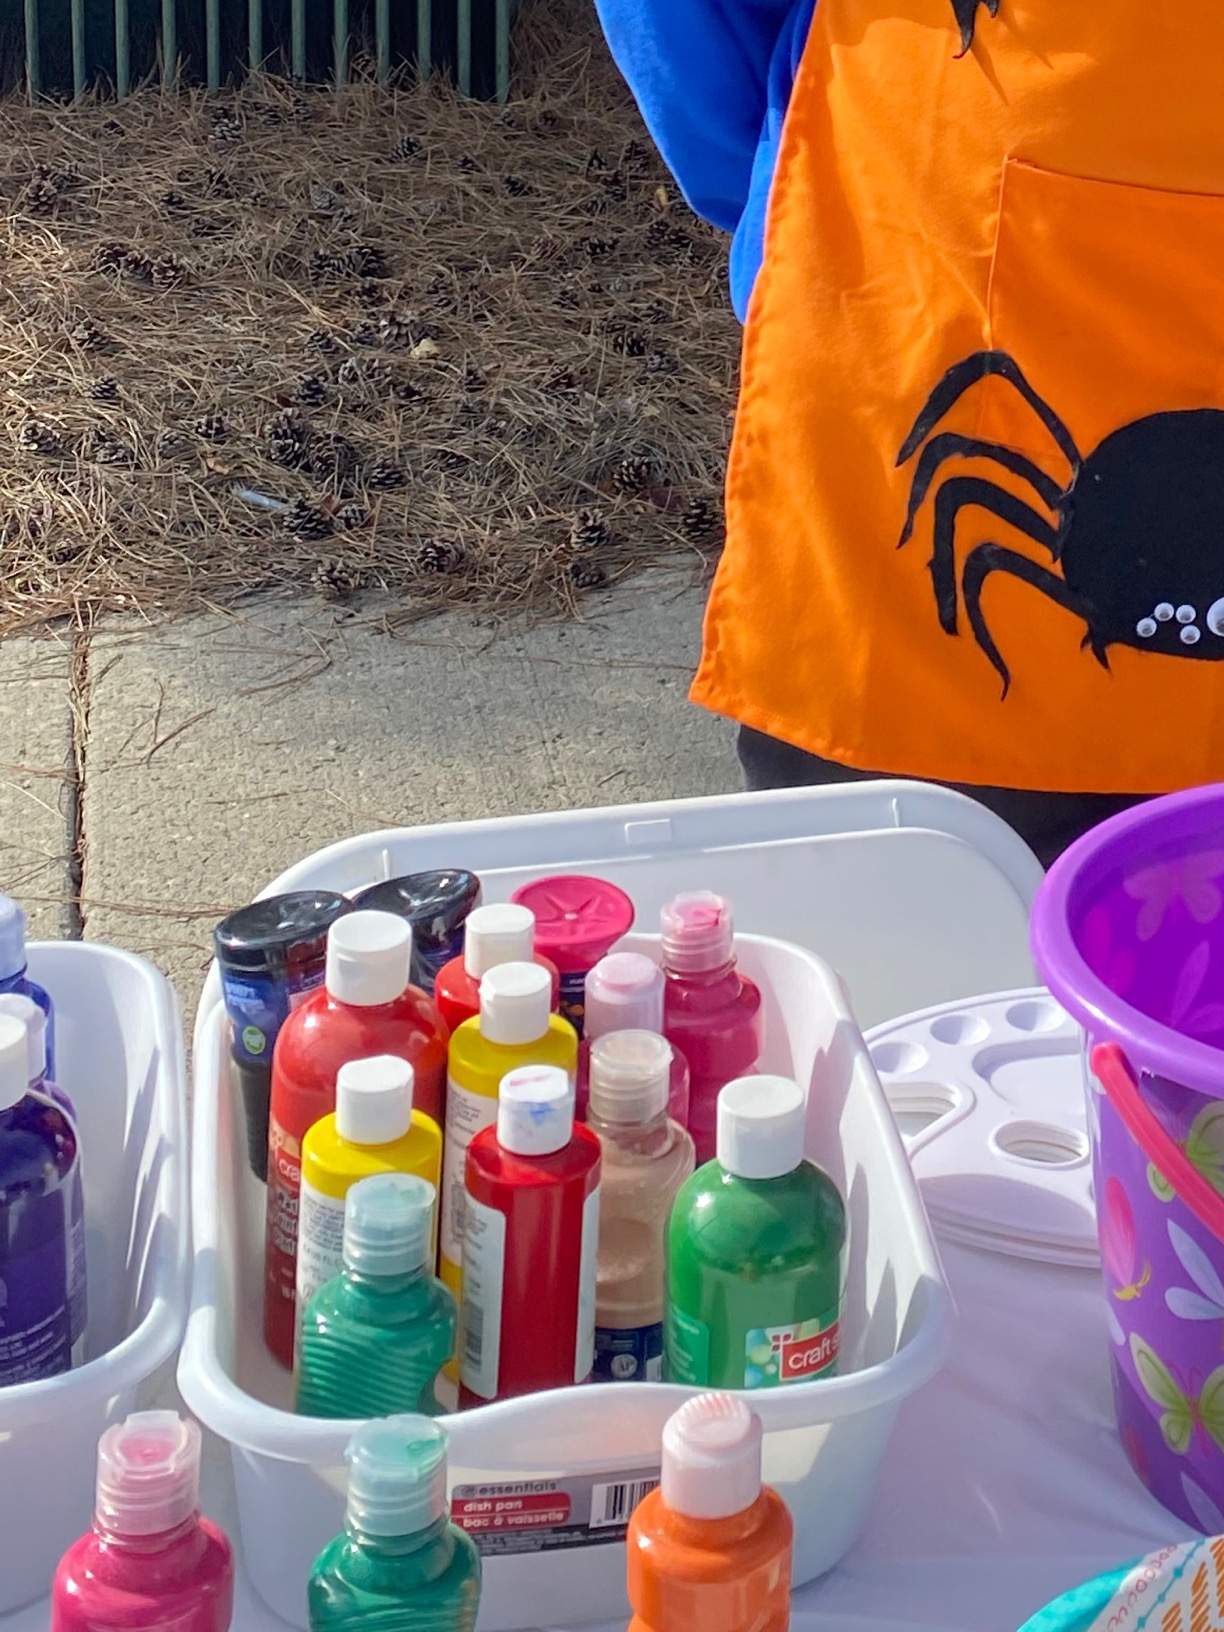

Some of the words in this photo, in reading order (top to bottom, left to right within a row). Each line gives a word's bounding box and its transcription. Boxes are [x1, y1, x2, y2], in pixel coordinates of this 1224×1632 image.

[479, 1481, 557, 1496] essentials
[463, 1501, 492, 1513] dish
[495, 1499, 523, 1513] pan
[463, 1517, 489, 1528] bac
[507, 1511, 564, 1525] vaisselle
